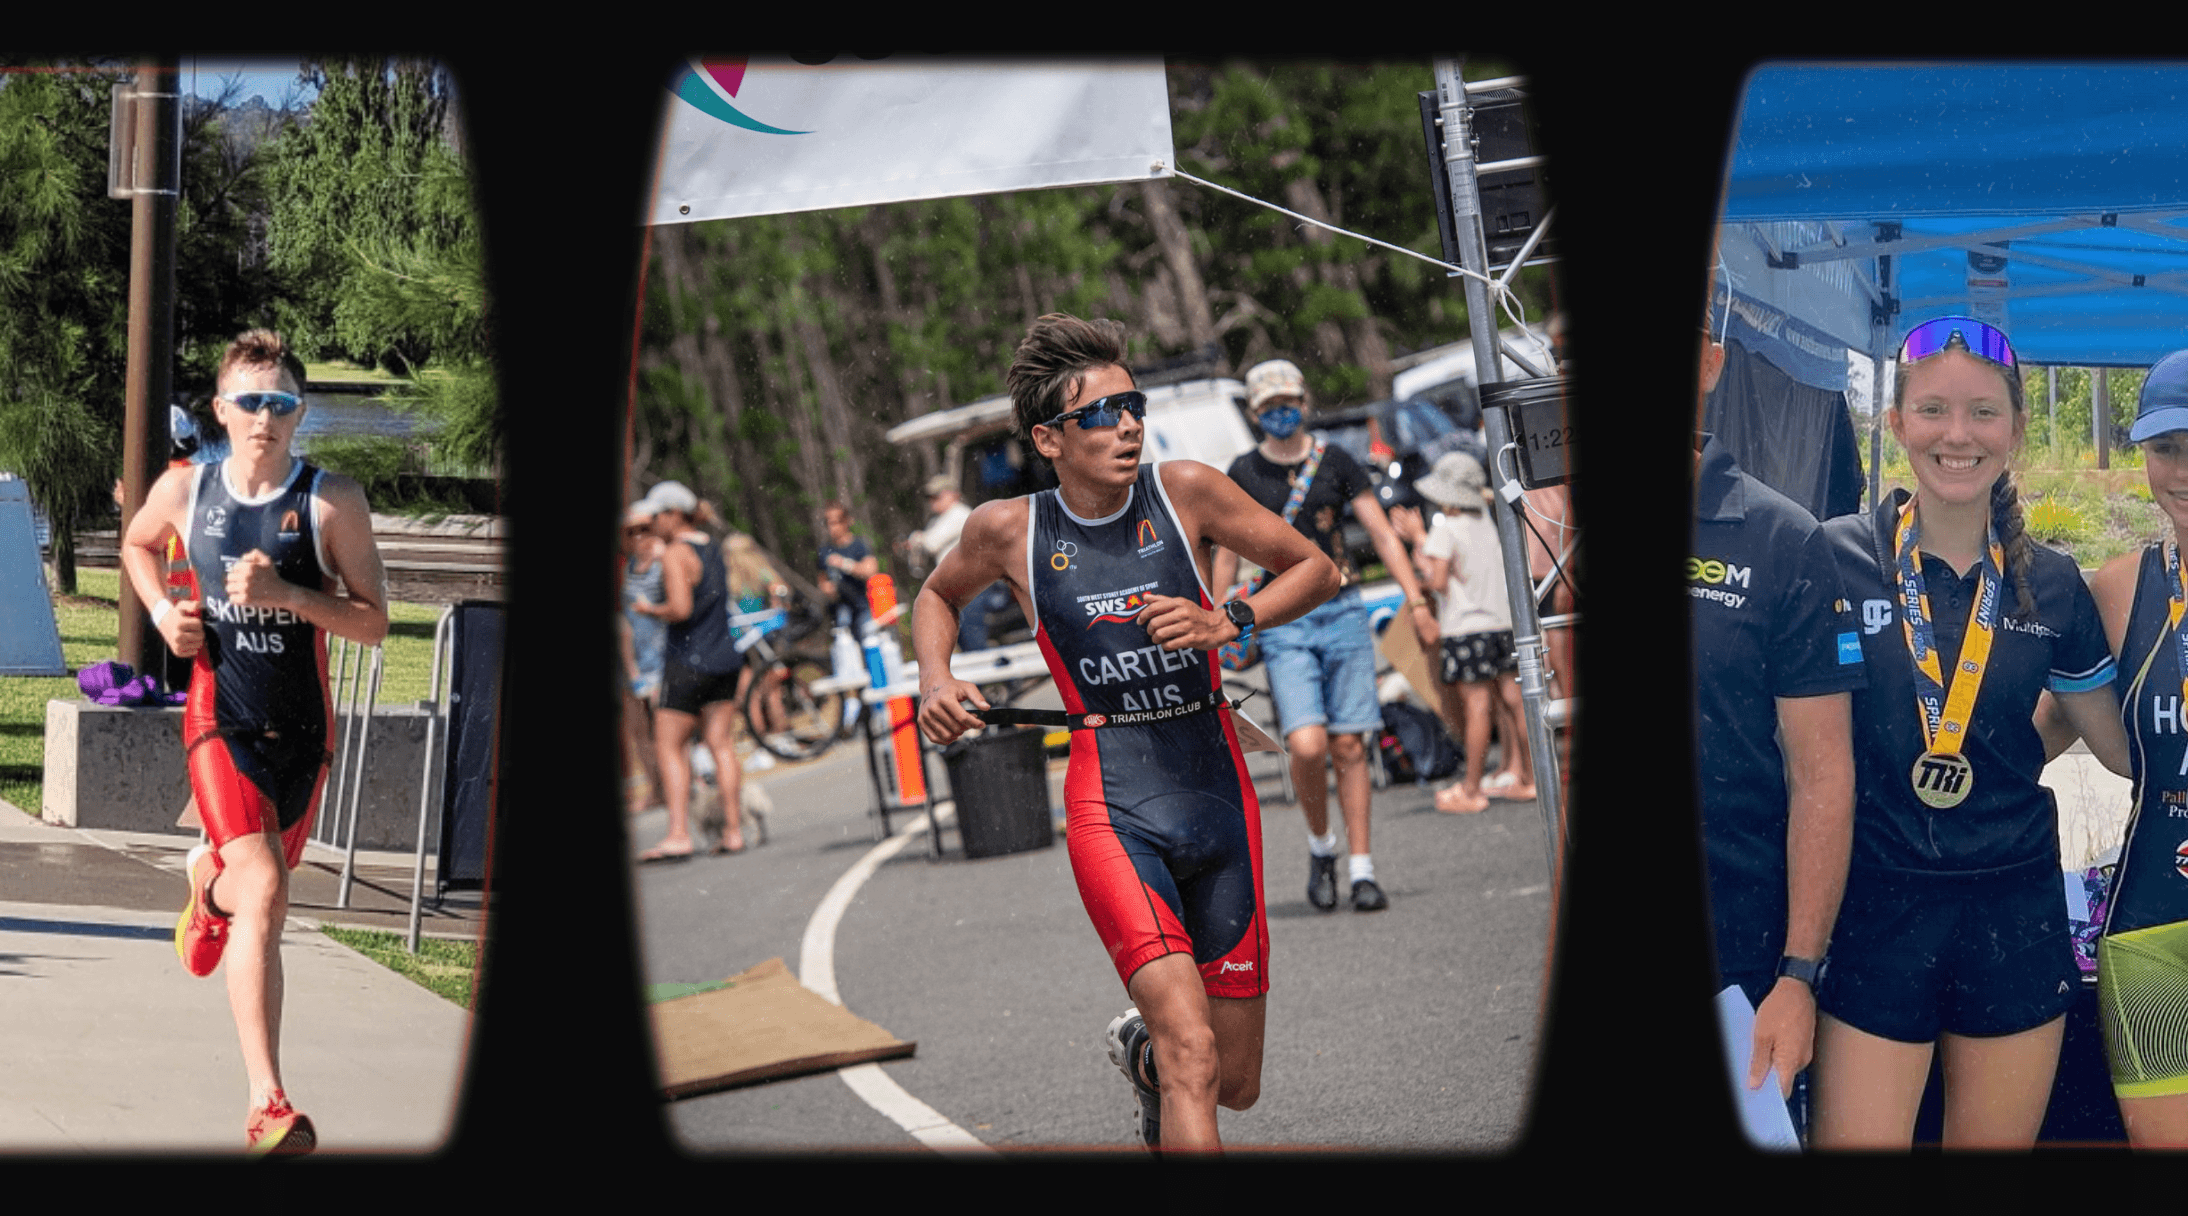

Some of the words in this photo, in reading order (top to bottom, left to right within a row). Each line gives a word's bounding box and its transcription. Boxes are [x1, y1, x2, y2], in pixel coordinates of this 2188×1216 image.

[1084, 591, 1151, 616] SWSA
[1684, 586, 1746, 609] energy
[1904, 579, 1924, 626] SERIES
[1975, 577, 1996, 632] SPRINT
[235, 629, 285, 654] AUS
[1079, 643, 1199, 686] CARTER
[1121, 684, 1184, 712] AUS
[1110, 708, 1173, 724] TRIATHLON
[1174, 701, 1201, 717] CLUB
[1925, 696, 1941, 739] SPRI
